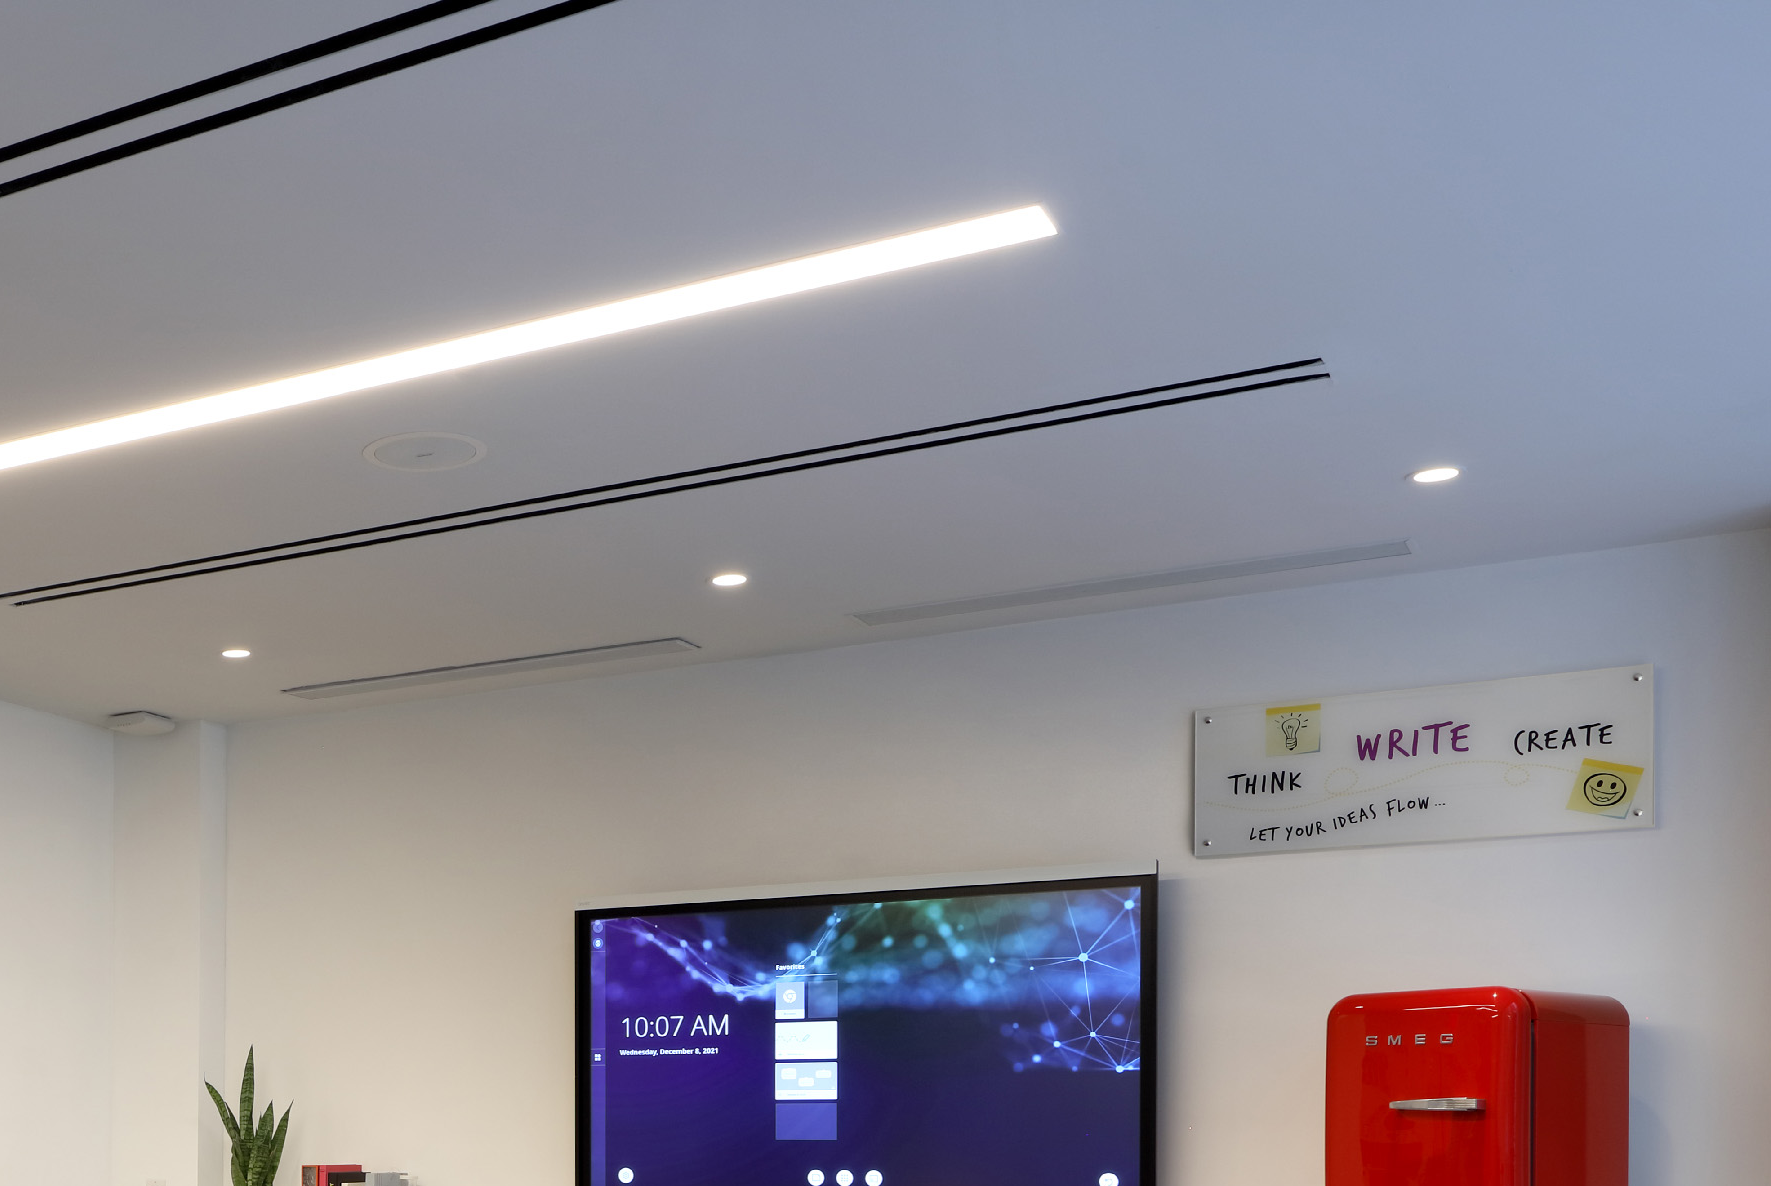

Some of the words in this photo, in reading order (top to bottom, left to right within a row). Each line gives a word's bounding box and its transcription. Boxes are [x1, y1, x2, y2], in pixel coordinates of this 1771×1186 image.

[1355, 721, 1472, 761] WRITE
[1513, 723, 1614, 756] CREATE
[1228, 770, 1303, 796] THINK
[1248, 826, 1280, 842] LET
[1285, 820, 1327, 840] YOUR
[1332, 804, 1377, 831] IDEAS
[621, 1015, 684, 1038] 10:07
[690, 1013, 729, 1037] AM
[619, 1048, 658, 1057] Wednesday,
[659, 1047, 694, 1055] December
[702, 1047, 719, 1055] 2021
[1365, 1033, 1454, 1046] SMEG
